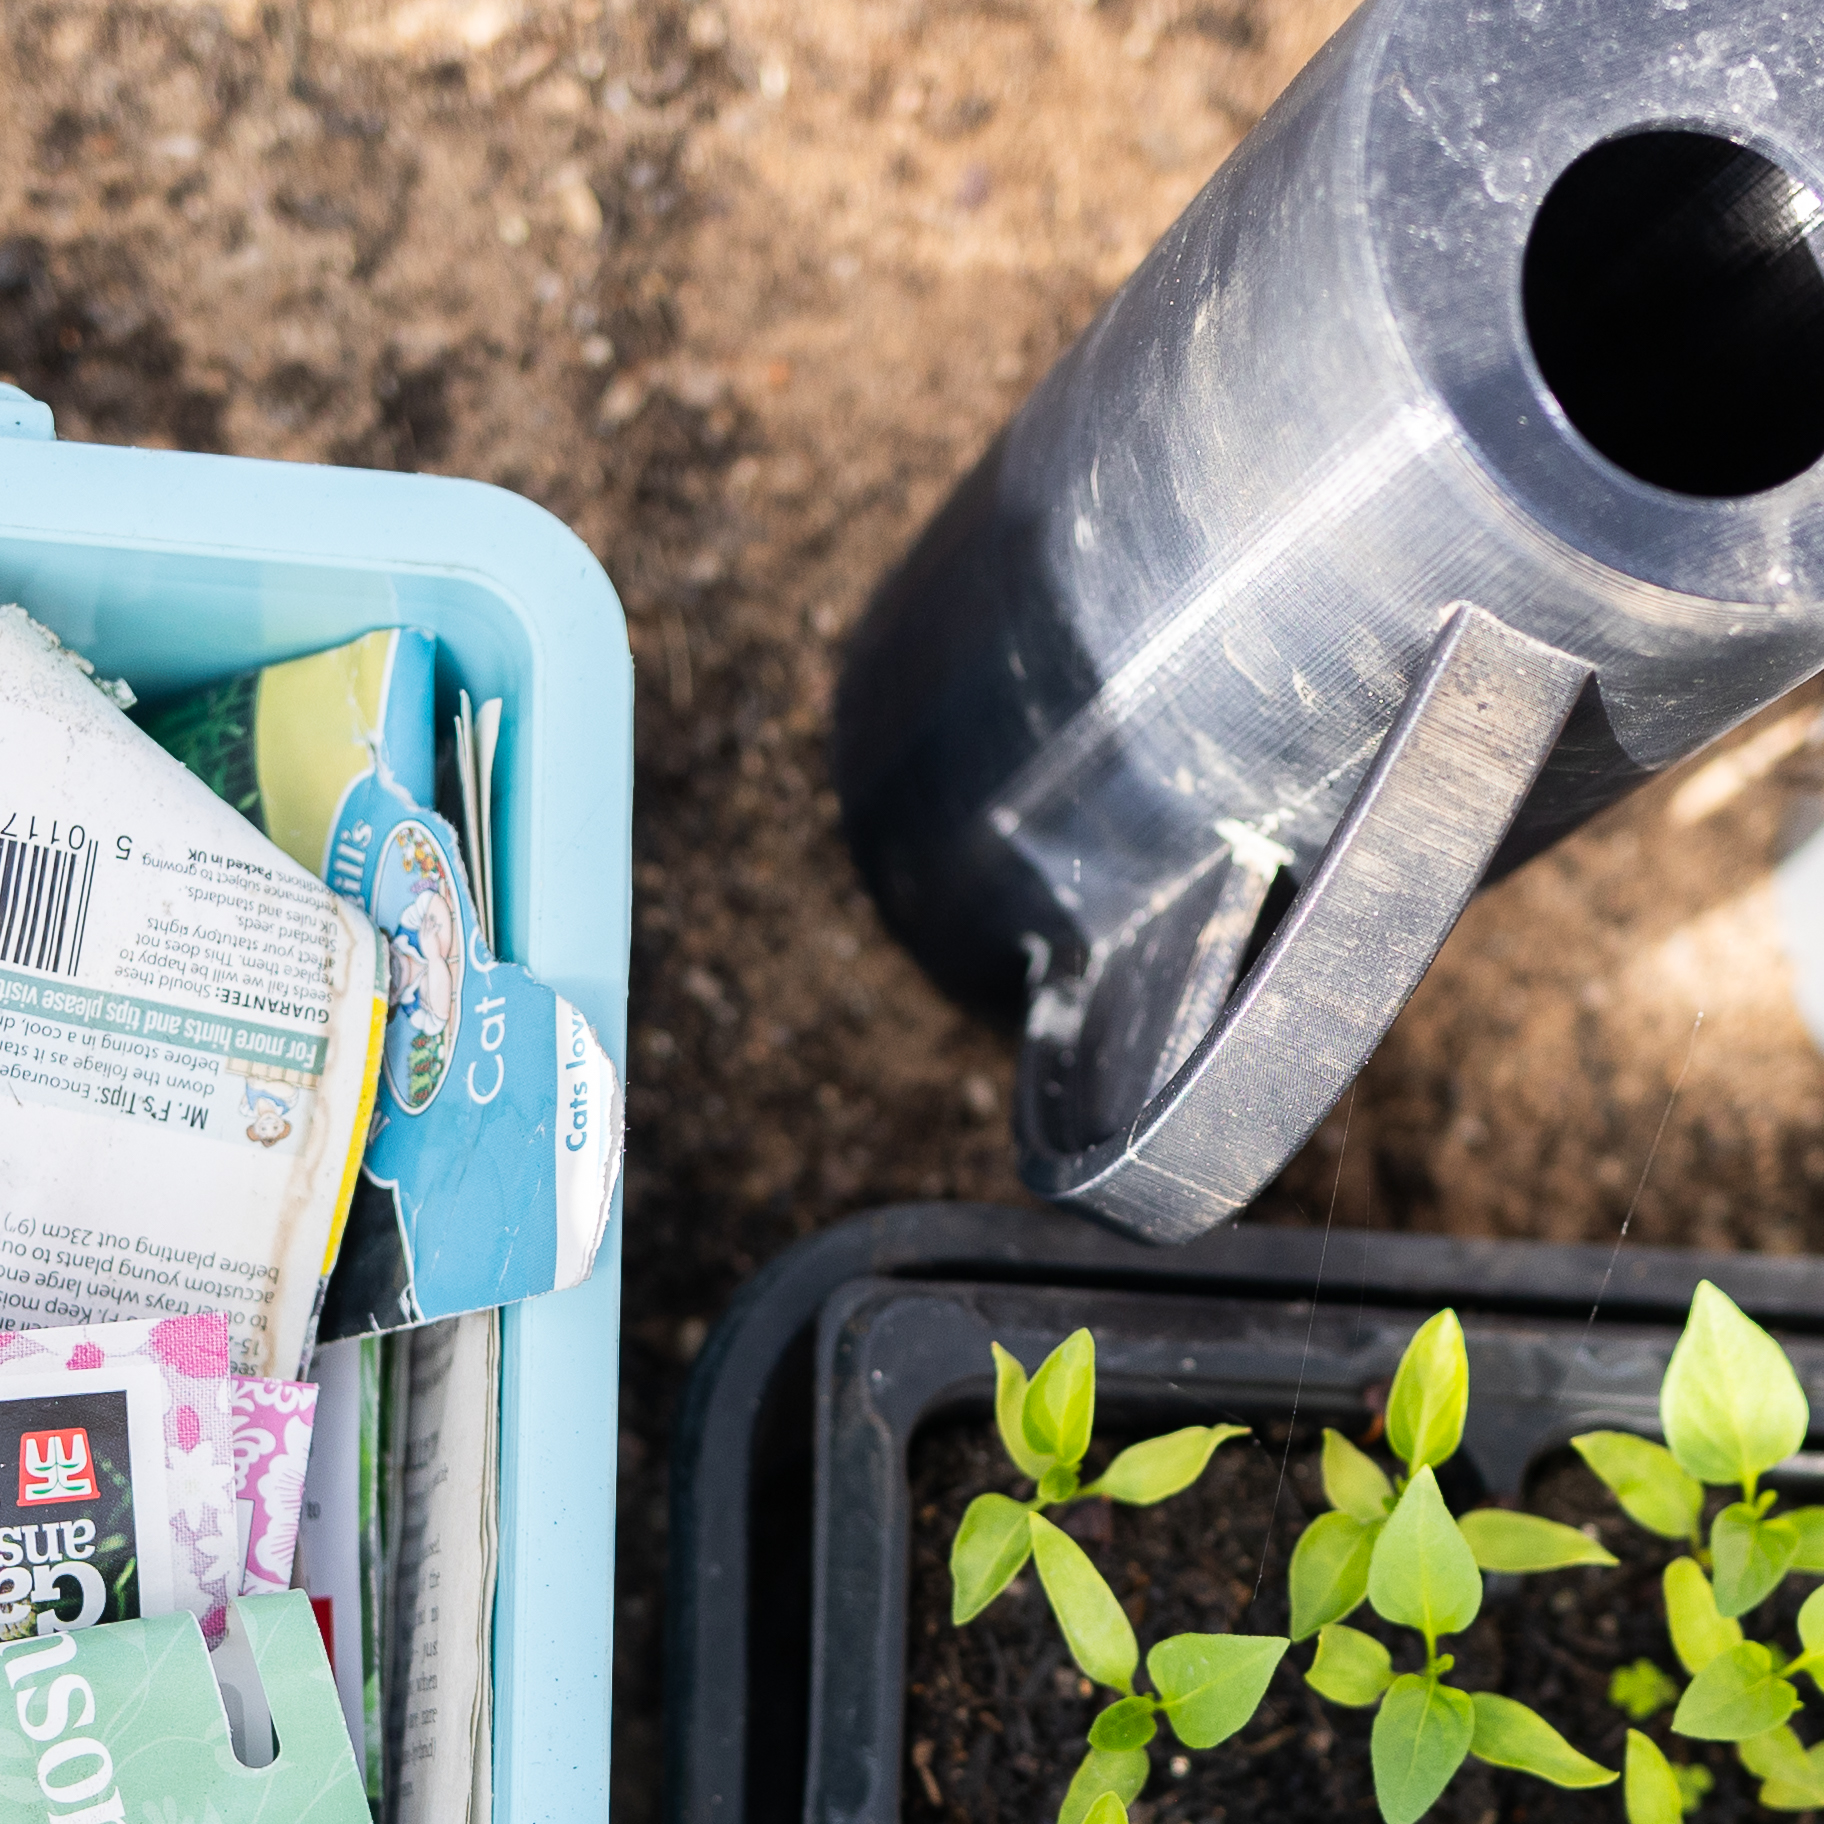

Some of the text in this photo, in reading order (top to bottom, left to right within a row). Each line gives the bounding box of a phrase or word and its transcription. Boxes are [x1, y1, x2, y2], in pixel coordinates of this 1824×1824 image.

[115, 835, 133, 860] 5
[188, 848, 272, 880] Packed UK
[192, 924, 295, 957] your statutory
[135, 933, 334, 986] replace them. This does not
[137, 949, 333, 1004] seeds fail will be happy
[41, 982, 103, 1022] please
[114, 965, 330, 1024] GUARANTEE: Should these
[103, 995, 144, 1030] tips
[143, 1008, 182, 1040] and
[19, 1017, 62, 1041] cool,
[180, 1016, 233, 1050] hints
[233, 1027, 285, 1058] more
[100, 1033, 159, 1060] storing
[283, 1039, 317, 1069] For
[467, 996, 506, 1105] Cat
[72, 1055, 128, 1081] foliage
[164, 1050, 220, 1075] before
[0, 1063, 91, 1097] Encourage
[132, 1068, 160, 1086] the
[166, 1075, 215, 1097] down
[93, 1081, 138, 1114] Tips:
[177, 1102, 209, 1129] Mr.
[565, 1081, 588, 1151] Cats
[42, 1223, 92, 1245] 23cm
[97, 1232, 130, 1250] out
[31, 1247, 51, 1262] to
[56, 1251, 113, 1276] plants
[134, 1236, 216, 1270] planting
[34, 1271, 81, 1295] large
[118, 1259, 180, 1287] young
[220, 1262, 279, 1284] before
[86, 1282, 140, 1304] when
[145, 1293, 189, 1313] trays
[184, 1277, 274, 1307] accustom
[44, 1298, 92, 1320] Keep
[248, 1312, 268, 1329] to
